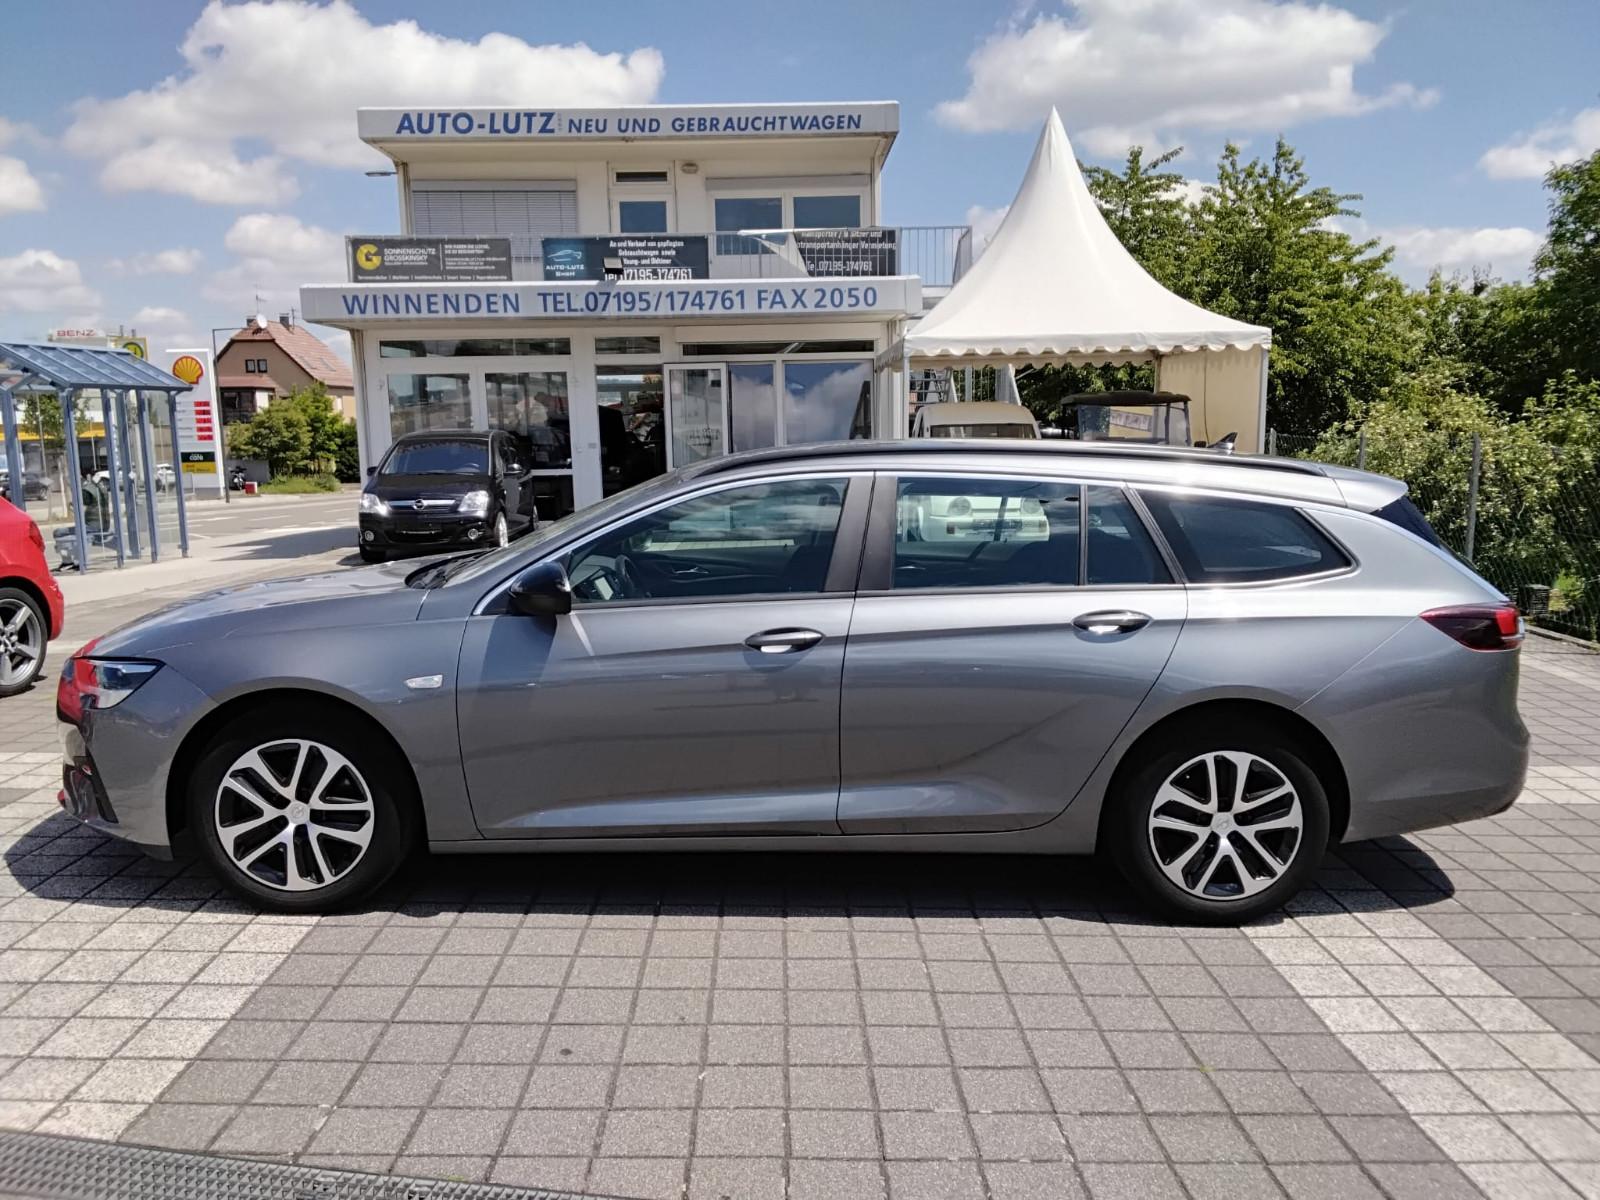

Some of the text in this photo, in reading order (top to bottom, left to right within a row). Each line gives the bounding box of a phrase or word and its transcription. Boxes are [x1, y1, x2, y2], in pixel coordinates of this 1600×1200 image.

[396, 112, 555, 134] AUTO-LUTZ
[568, 118, 608, 133] NEU
[617, 118, 661, 133] UND
[672, 114, 862, 132] GEBRAUCHTWAGEN
[618, 249, 659, 257] Gebrauchtwagen
[342, 293, 520, 315] WINNENDEN
[56, 329, 95, 337] BENZ
